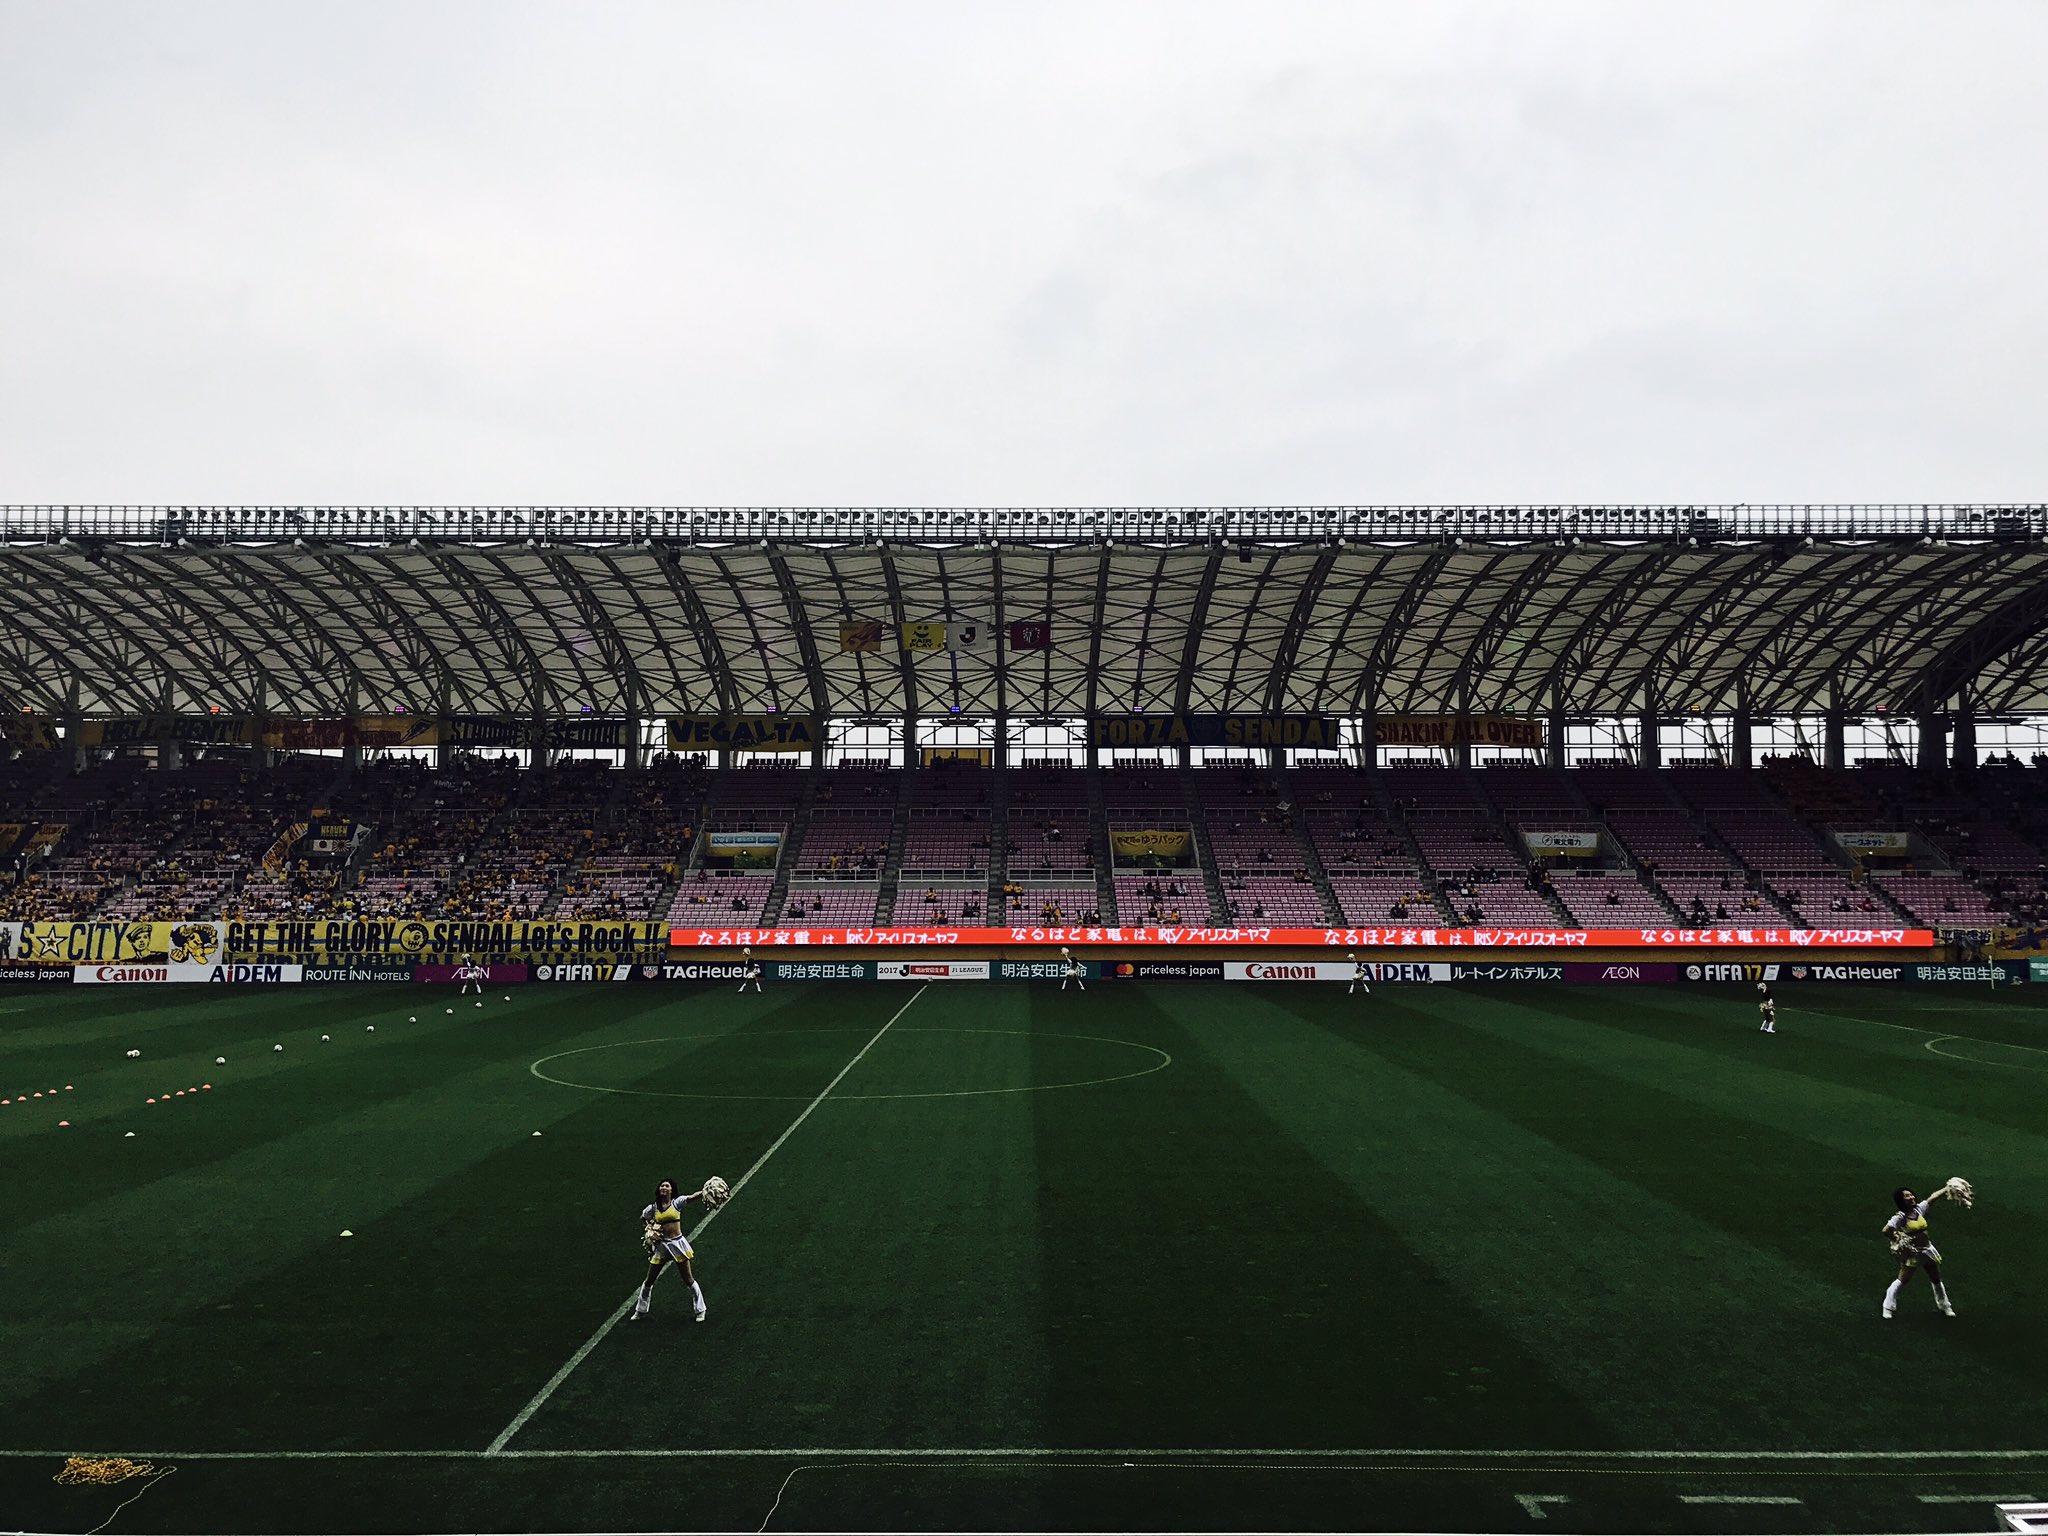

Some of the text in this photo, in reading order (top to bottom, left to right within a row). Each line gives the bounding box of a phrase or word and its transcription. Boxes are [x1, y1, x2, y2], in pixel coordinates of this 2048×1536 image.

[668, 719, 813, 743] VEGALTA
[1093, 718, 1338, 746] FORZA SENDAI
[1453, 719, 1483, 742] ALL
[1488, 721, 1536, 745] OVER
[68, 923, 130, 961] CITY
[228, 923, 268, 952] GET
[276, 923, 316, 952] THE
[325, 923, 396, 952] GLORY
[432, 923, 513, 952] SENDAI
[520, 923, 573, 952] Let's
[578, 923, 636, 952] Rock
[37, 968, 70, 981] japan
[96, 966, 168, 982] Canon
[306, 969, 346, 980] ROUTE
[374, 971, 410, 981] HOTELS
[555, 965, 614, 981] FIFA 17
[778, 964, 865, 979] 明治安田生命
[1140, 964, 1220, 977] priceless japan
[1246, 963, 1316, 979] Canon
[1511, 966, 1562, 979] ホテルズ
[1705, 965, 1762, 981] FIFA 17
[1916, 966, 2006, 981] 明治安田生命
